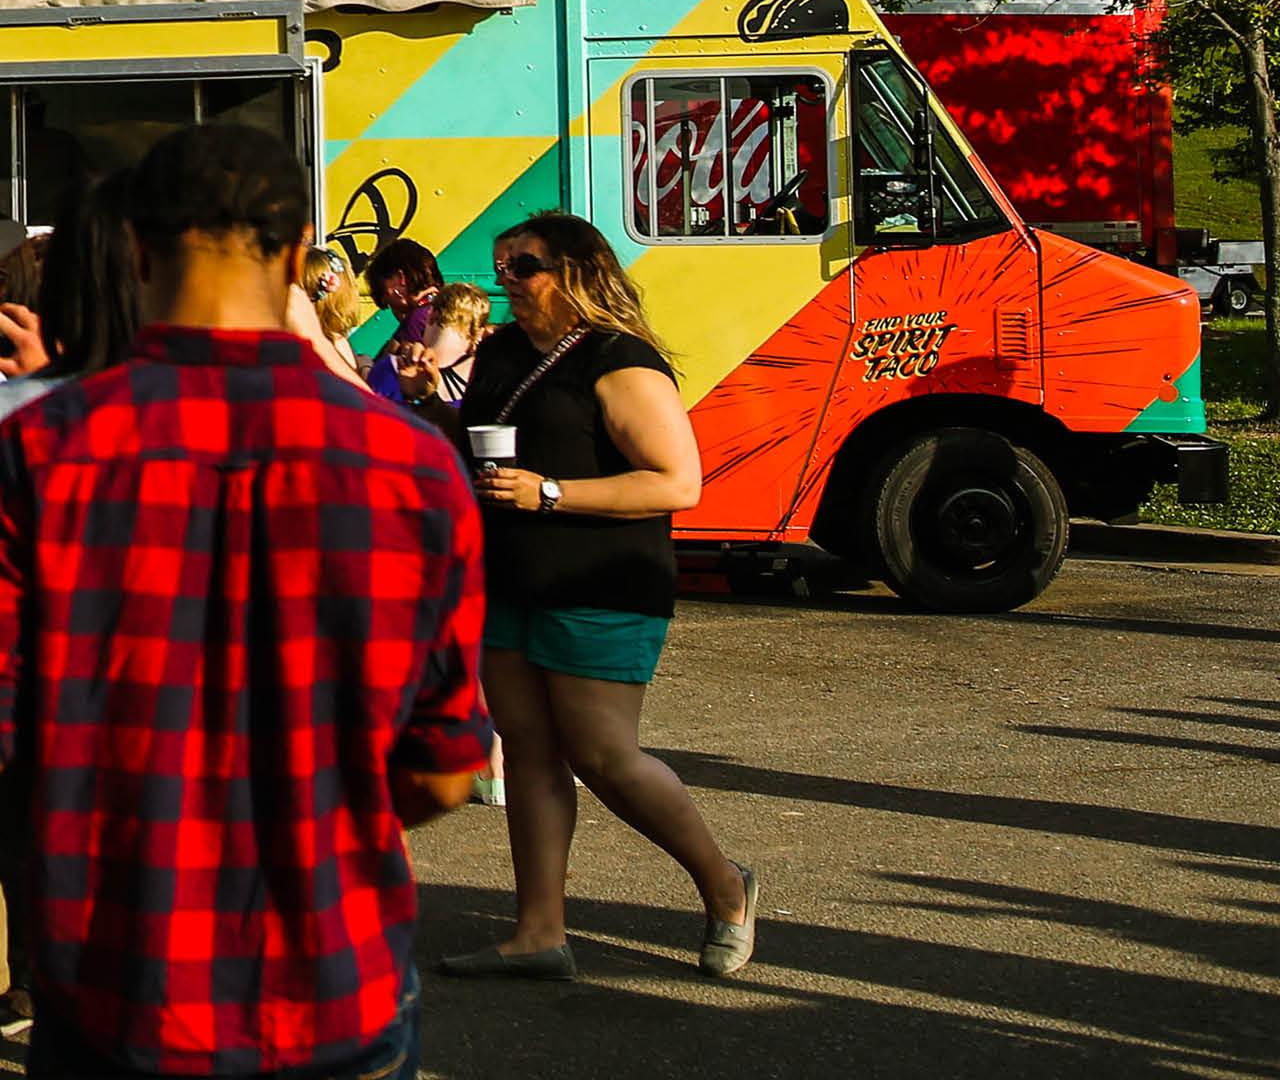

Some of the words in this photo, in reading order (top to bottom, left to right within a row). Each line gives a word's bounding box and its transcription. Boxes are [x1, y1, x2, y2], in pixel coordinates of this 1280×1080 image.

[862, 315, 902, 334] FIND
[903, 310, 947, 329] YOUR
[850, 323, 958, 360] SPIRIT
[862, 350, 939, 382] TACO
